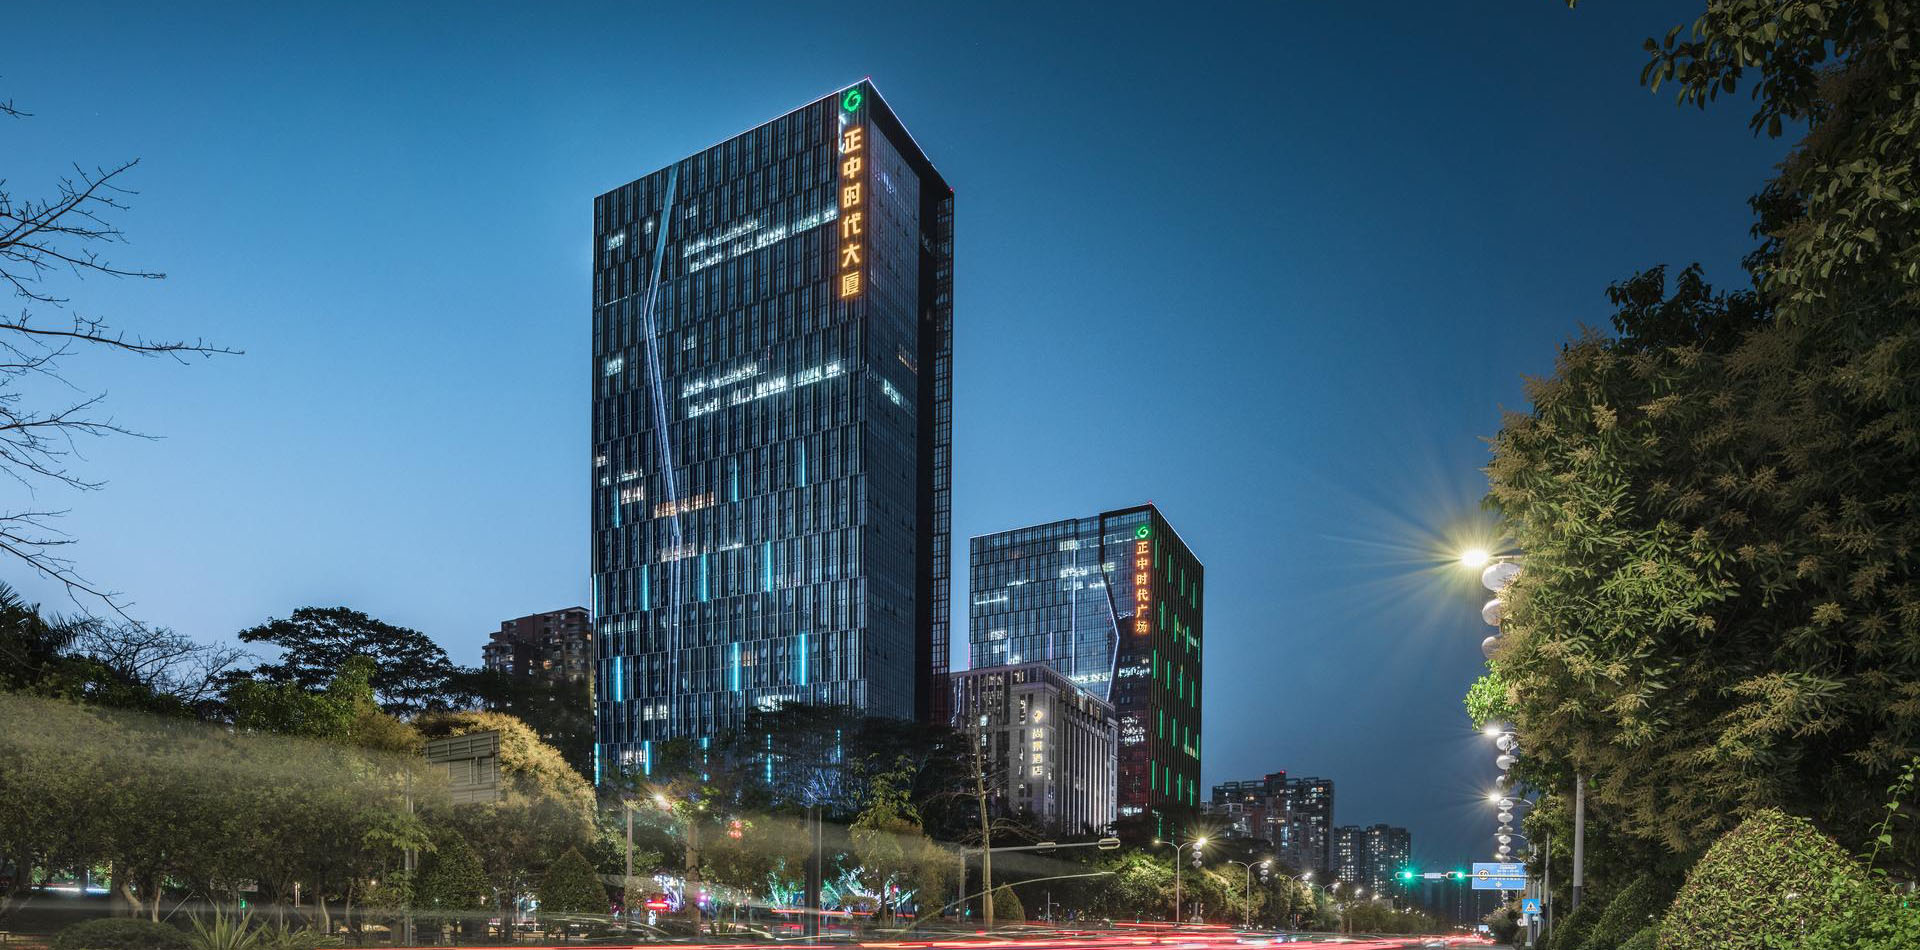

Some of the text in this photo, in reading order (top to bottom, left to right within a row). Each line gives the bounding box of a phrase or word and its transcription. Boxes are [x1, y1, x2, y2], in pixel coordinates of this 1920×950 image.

[842, 127, 862, 297] 正中时代大厦
[1136, 541, 1149, 633] 正中时代广场
